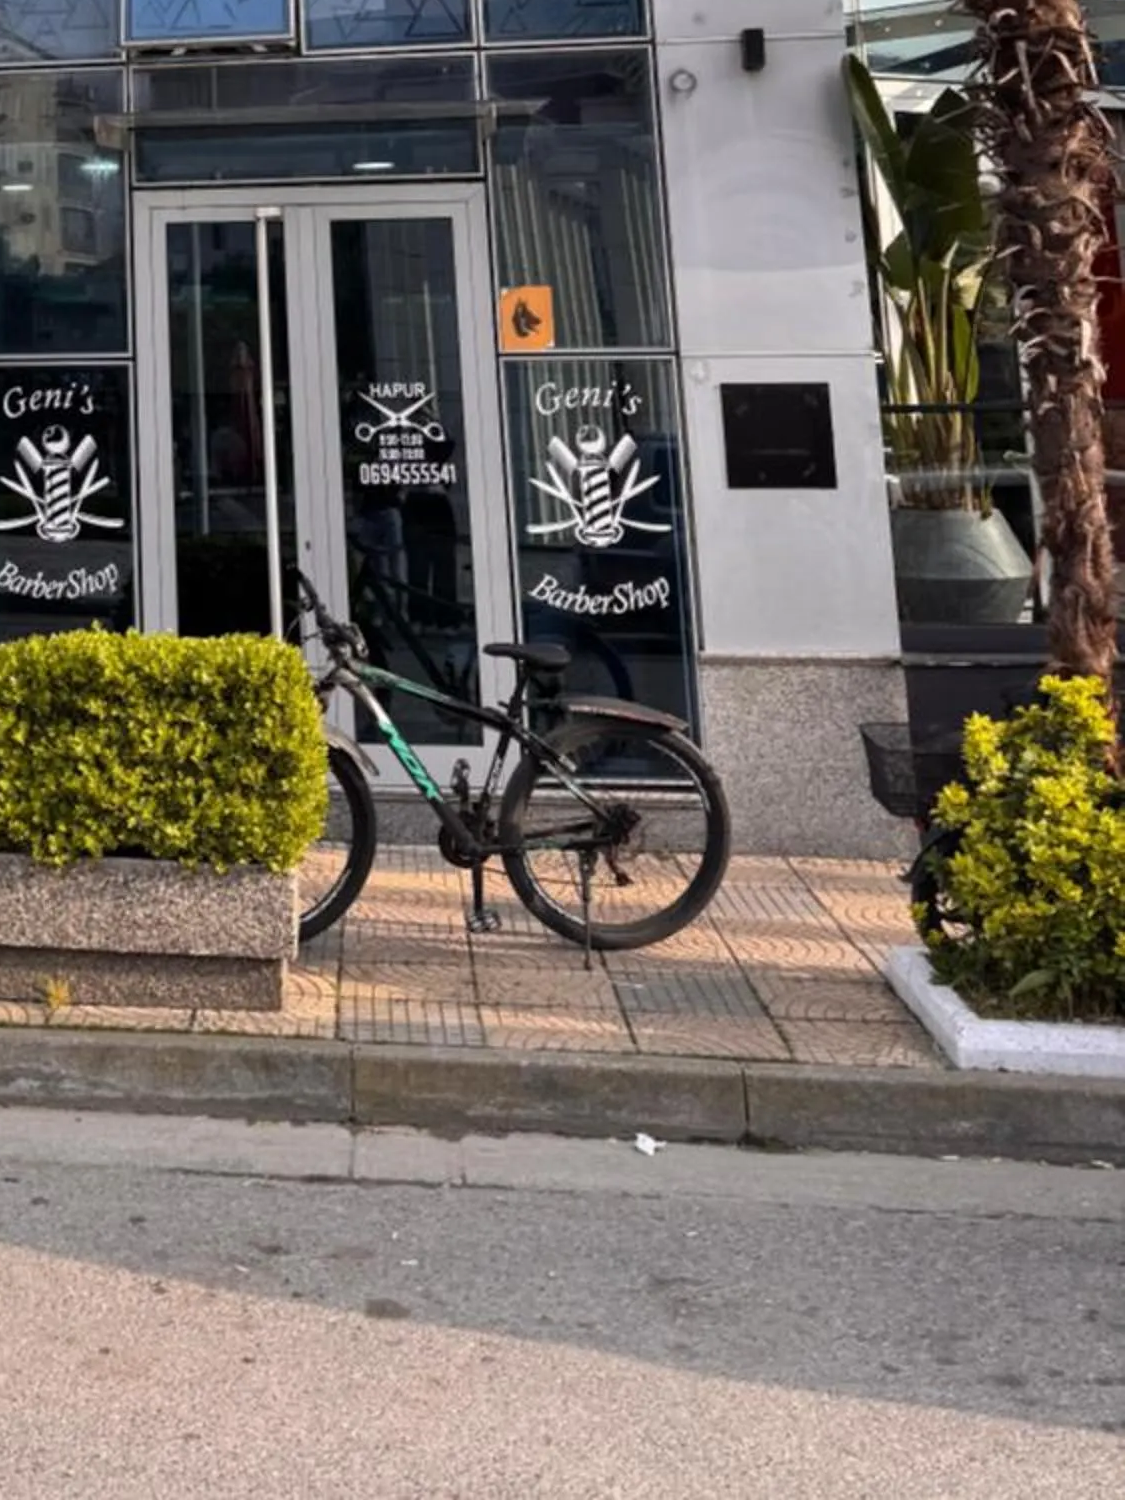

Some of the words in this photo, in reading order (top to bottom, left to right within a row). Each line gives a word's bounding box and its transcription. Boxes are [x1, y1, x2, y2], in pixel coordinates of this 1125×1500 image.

[2, 382, 95, 419] Geni's
[369, 382, 426, 398] HAPUR
[535, 380, 643, 416] Geni's
